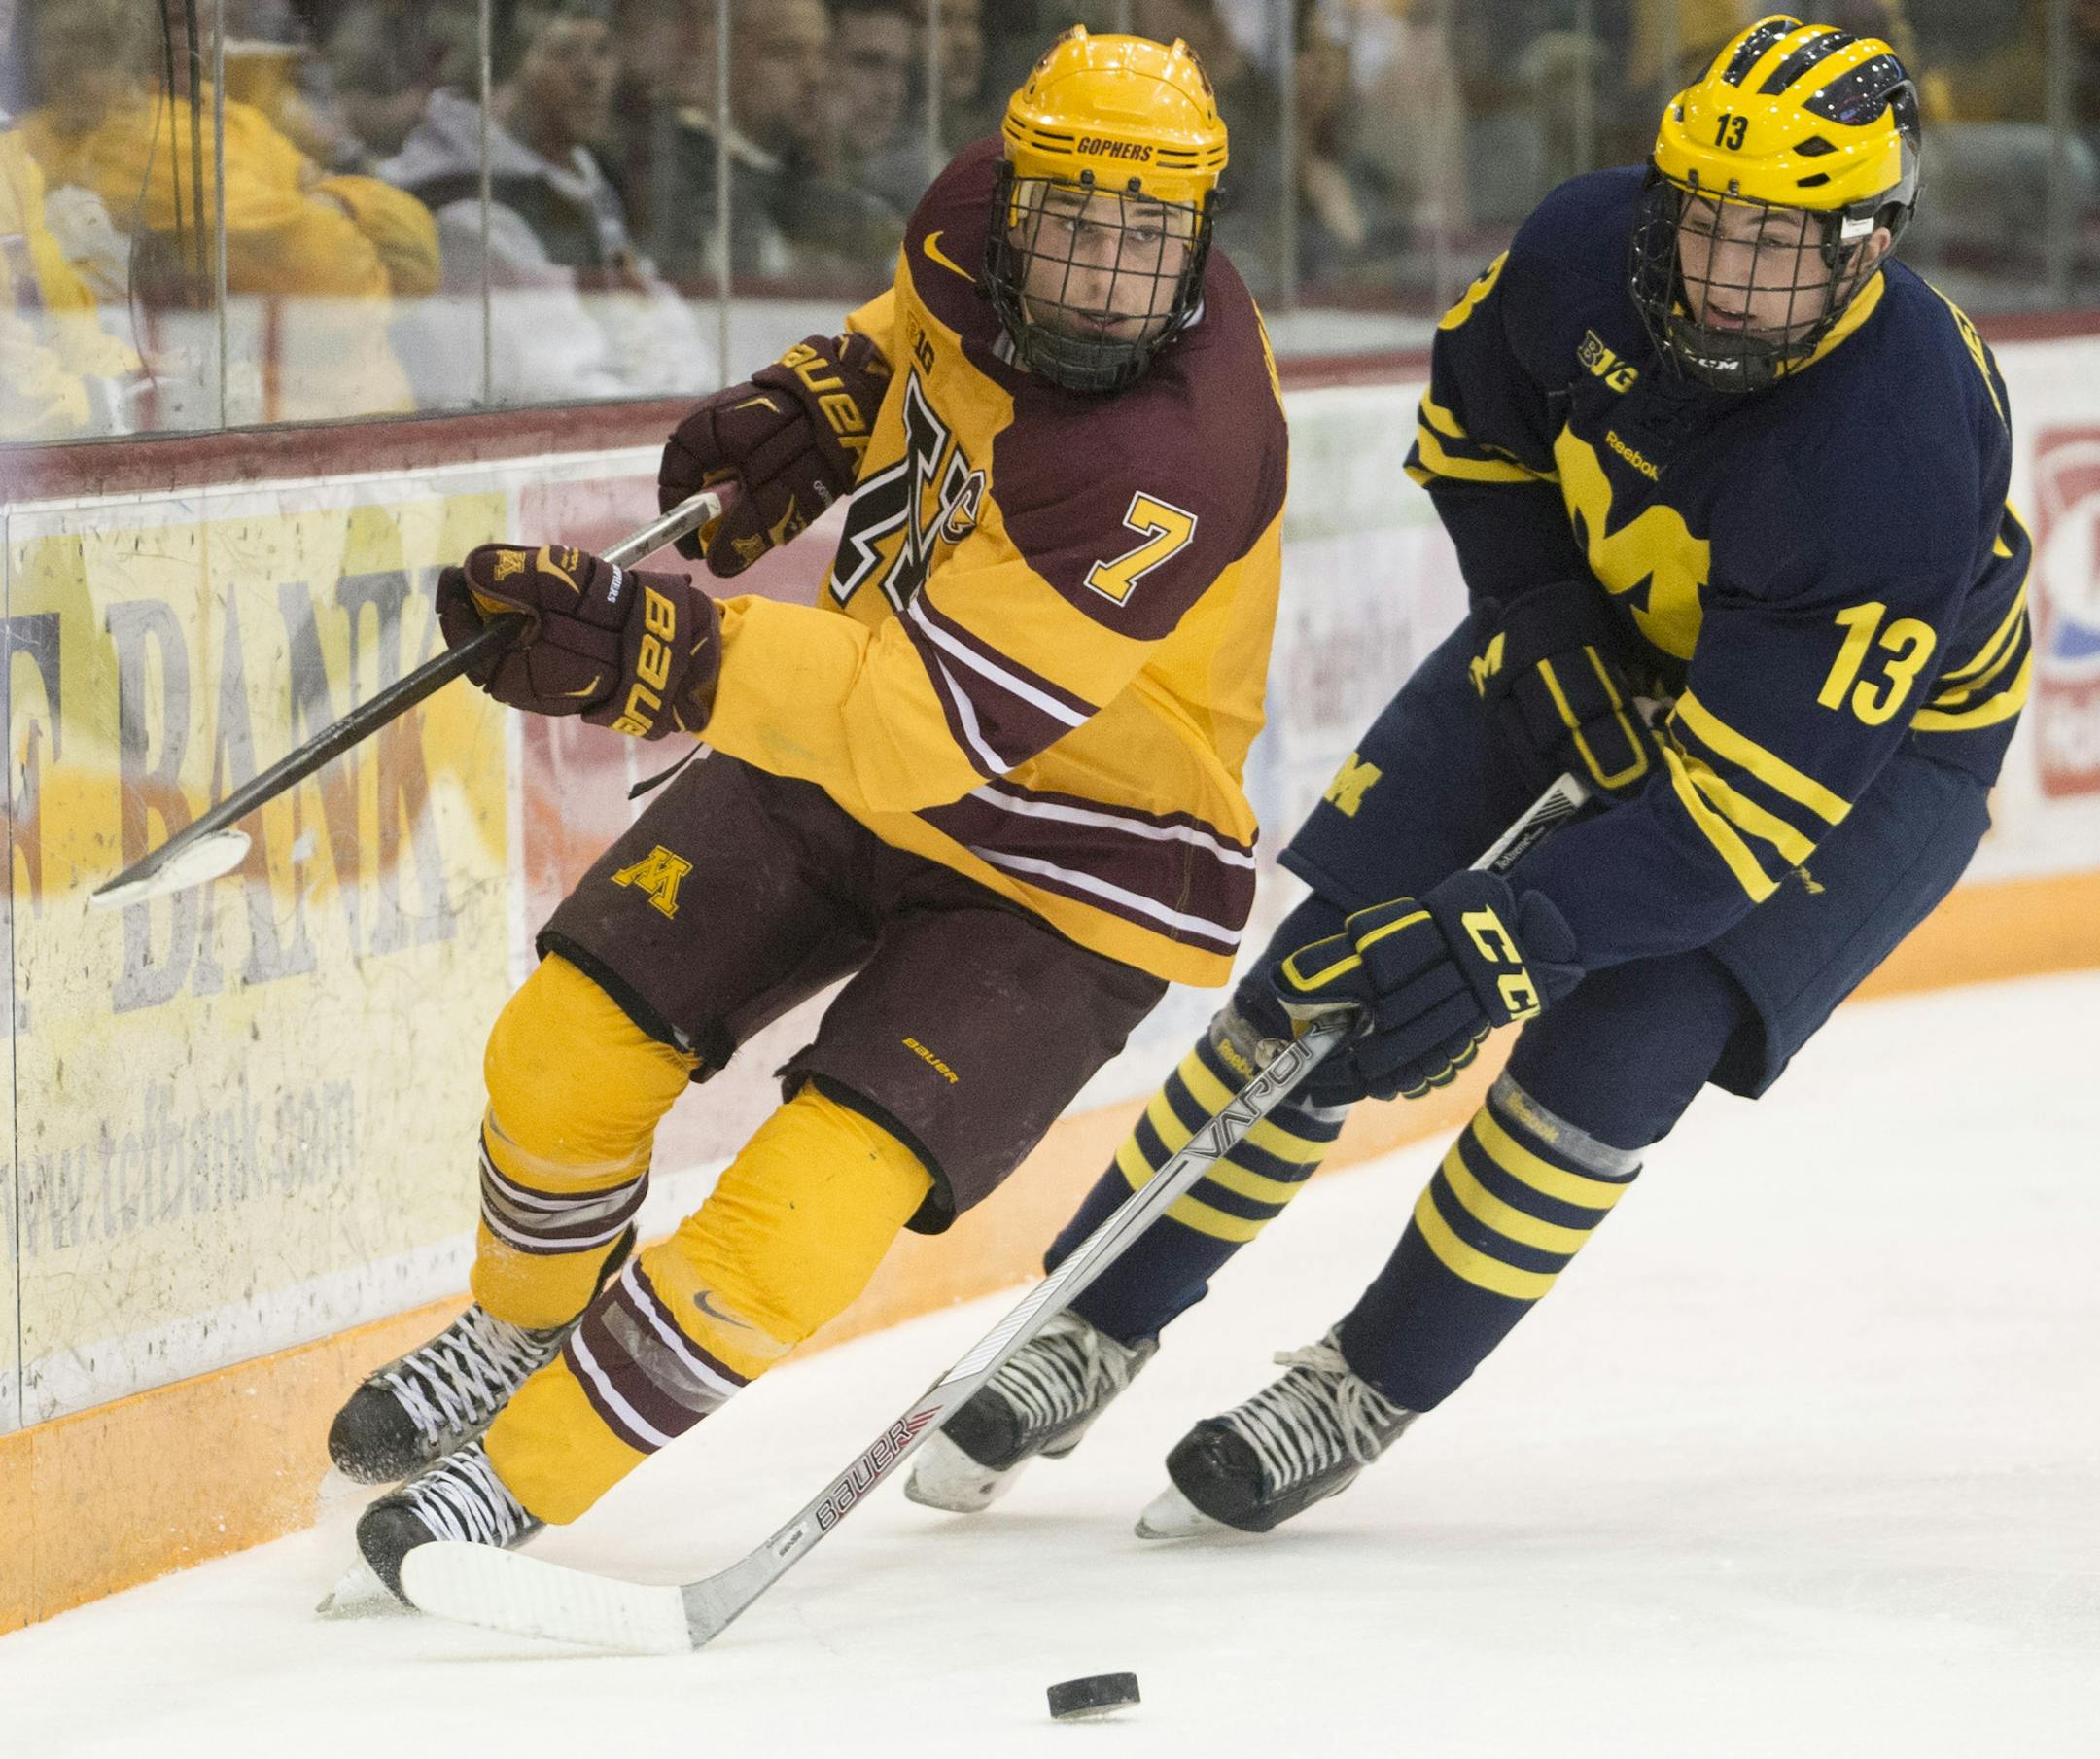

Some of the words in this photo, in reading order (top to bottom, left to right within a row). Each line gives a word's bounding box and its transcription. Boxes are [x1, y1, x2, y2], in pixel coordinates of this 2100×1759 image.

[1076, 136, 1154, 163] GOPHERS
[1714, 113, 1749, 152] 13
[1605, 429, 1661, 482] Reebok
[1083, 490, 1198, 608] 7
[1553, 420, 1712, 661] M
[1468, 632, 1506, 700] M
[1817, 601, 1938, 726] 13
[104, 562, 459, 1016] BANK
[1324, 751, 1382, 818] M
[610, 844, 693, 920] M
[1461, 903, 1541, 1021] CC
[901, 1037, 960, 1085] BAUER
[815, 1418, 914, 1533] BAUER
